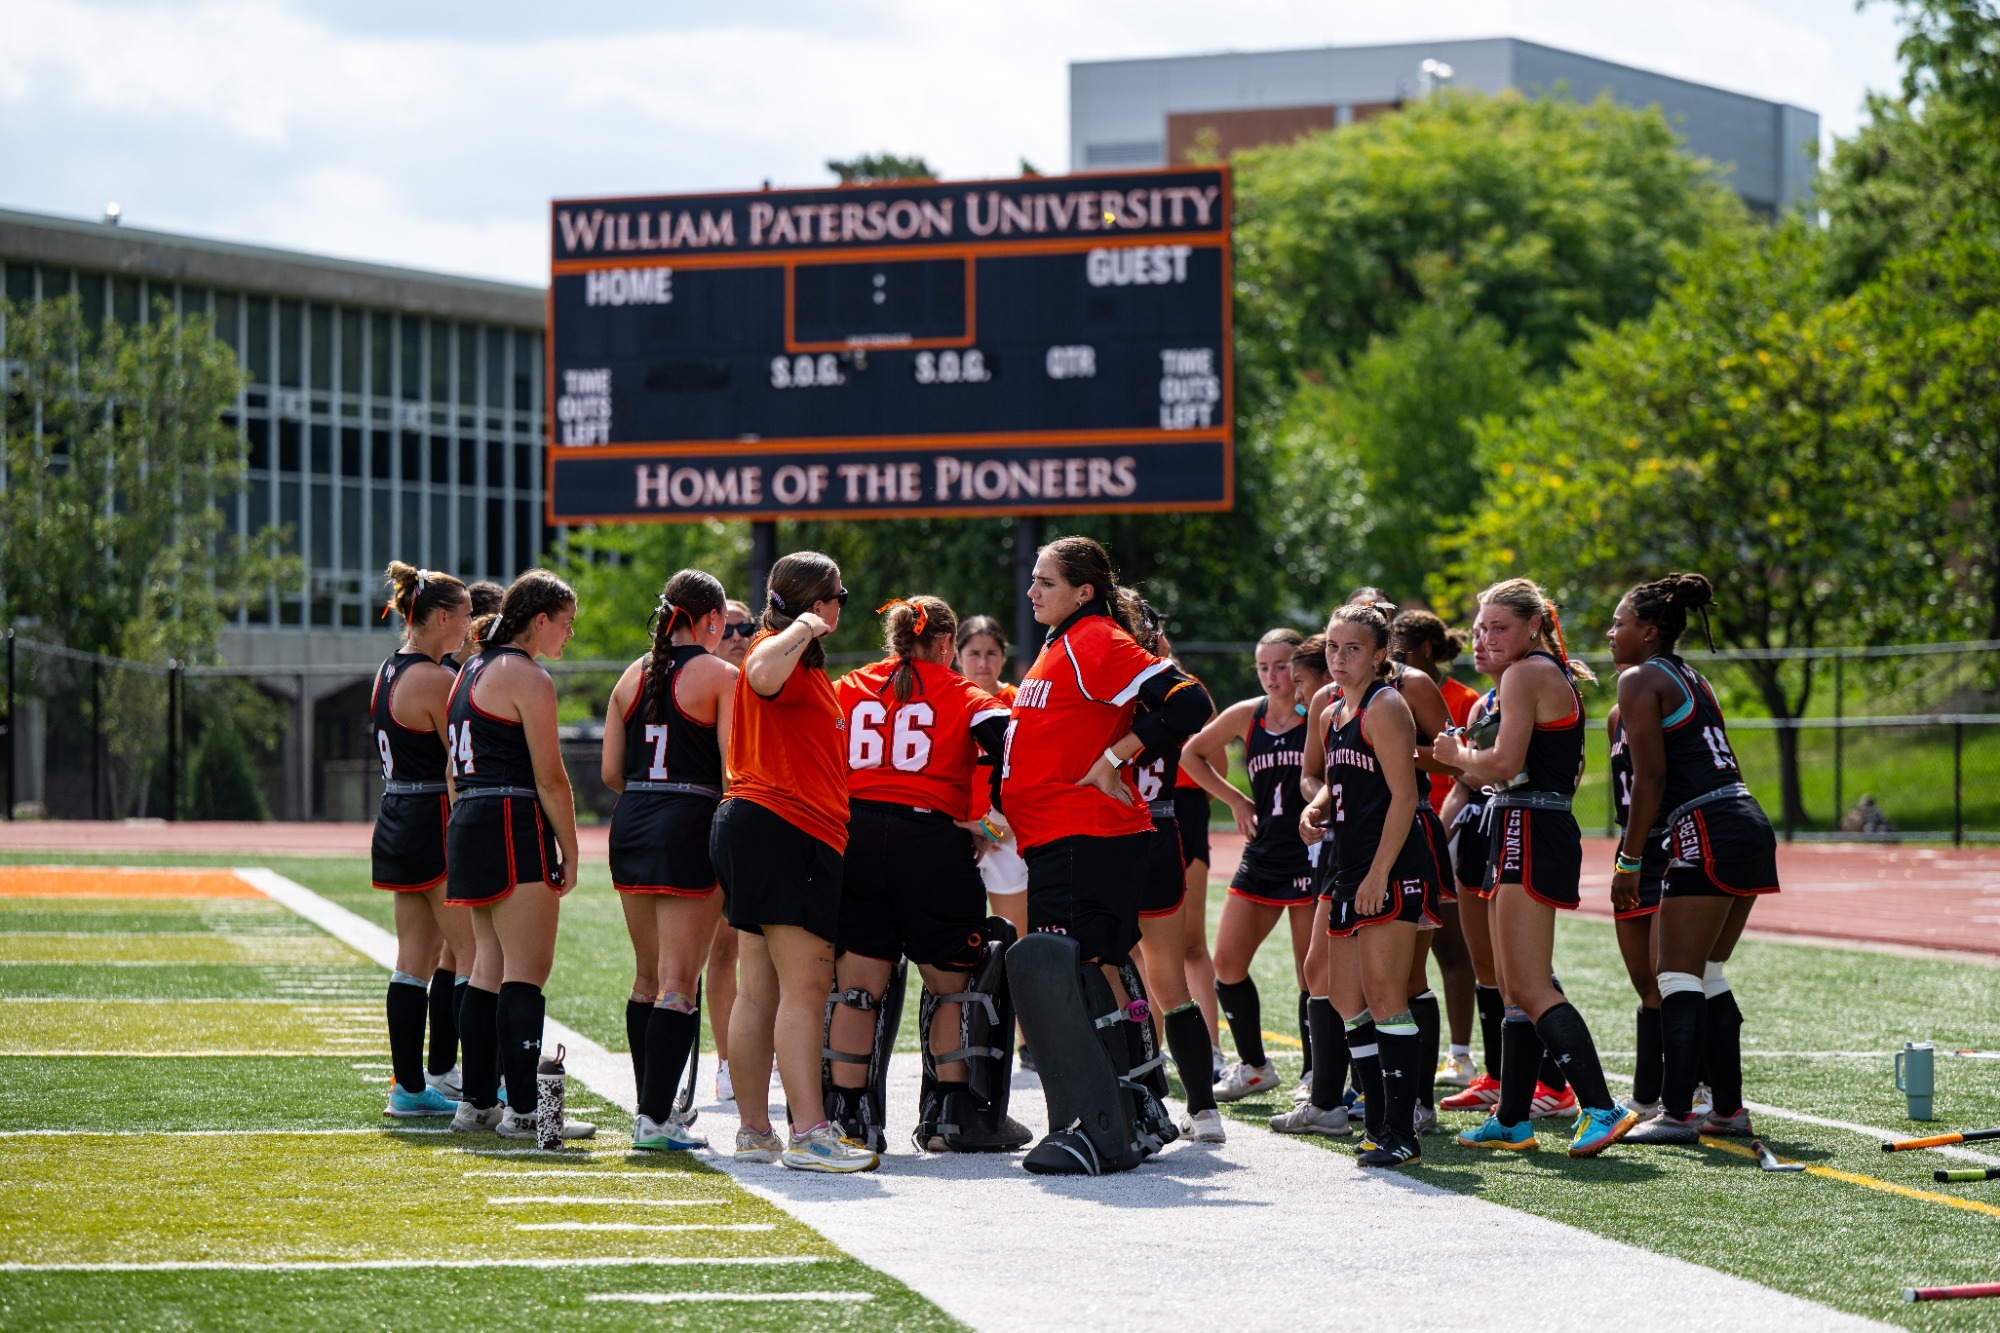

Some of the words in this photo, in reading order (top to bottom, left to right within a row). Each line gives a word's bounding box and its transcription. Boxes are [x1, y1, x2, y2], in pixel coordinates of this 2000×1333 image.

[558, 207, 736, 252] WILLIAM
[749, 198, 953, 244] PATERSON
[965, 187, 1219, 237] UNIVERSITY
[1086, 245, 1192, 287] GUEST
[586, 266, 673, 306] HOME
[771, 353, 845, 388] S.O.G.
[915, 350, 991, 384] S.O.G.
[1046, 346, 1096, 379] QTR
[1161, 348, 1213, 376] TIME
[563, 368, 612, 396] TIME
[1160, 374, 1220, 403] OUTS
[558, 394, 612, 421] OUTS
[1160, 402, 1213, 430] LEFT
[562, 419, 612, 446] LEFT
[636, 464, 762, 507] HOME
[772, 465, 828, 504] OF
[838, 463, 921, 503] THE
[935, 457, 1136, 500] PIONEERS
[644, 724, 668, 780] 7
[848, 700, 935, 773] 66
[377, 729, 394, 780] 9
[1271, 782, 1284, 816] 1
[1331, 783, 1345, 822] 2
